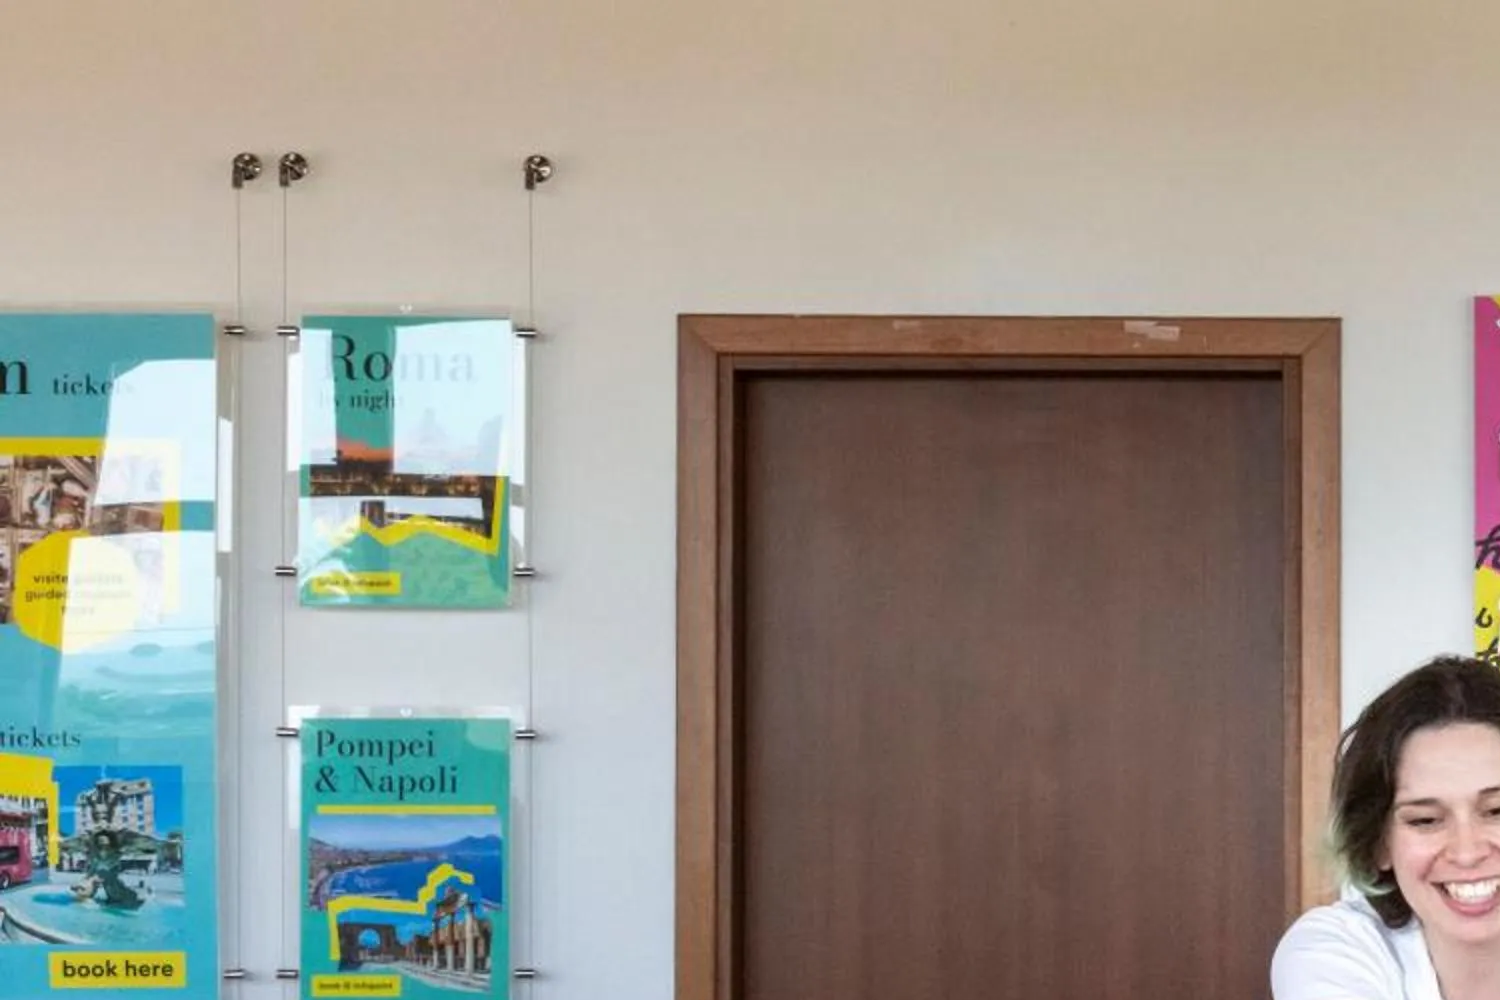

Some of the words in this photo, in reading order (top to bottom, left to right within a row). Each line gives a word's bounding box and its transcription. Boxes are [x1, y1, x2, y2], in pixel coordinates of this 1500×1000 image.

[322, 333, 478, 382] Roma
[53, 373, 134, 396] ticke
[33, 573, 69, 585] visite
[0, 728, 82, 748] tickets
[316, 729, 437, 766] Pompei
[314, 765, 338, 794] &
[353, 765, 458, 801] Napoli
[63, 960, 118, 978] book
[125, 960, 174, 978] here
